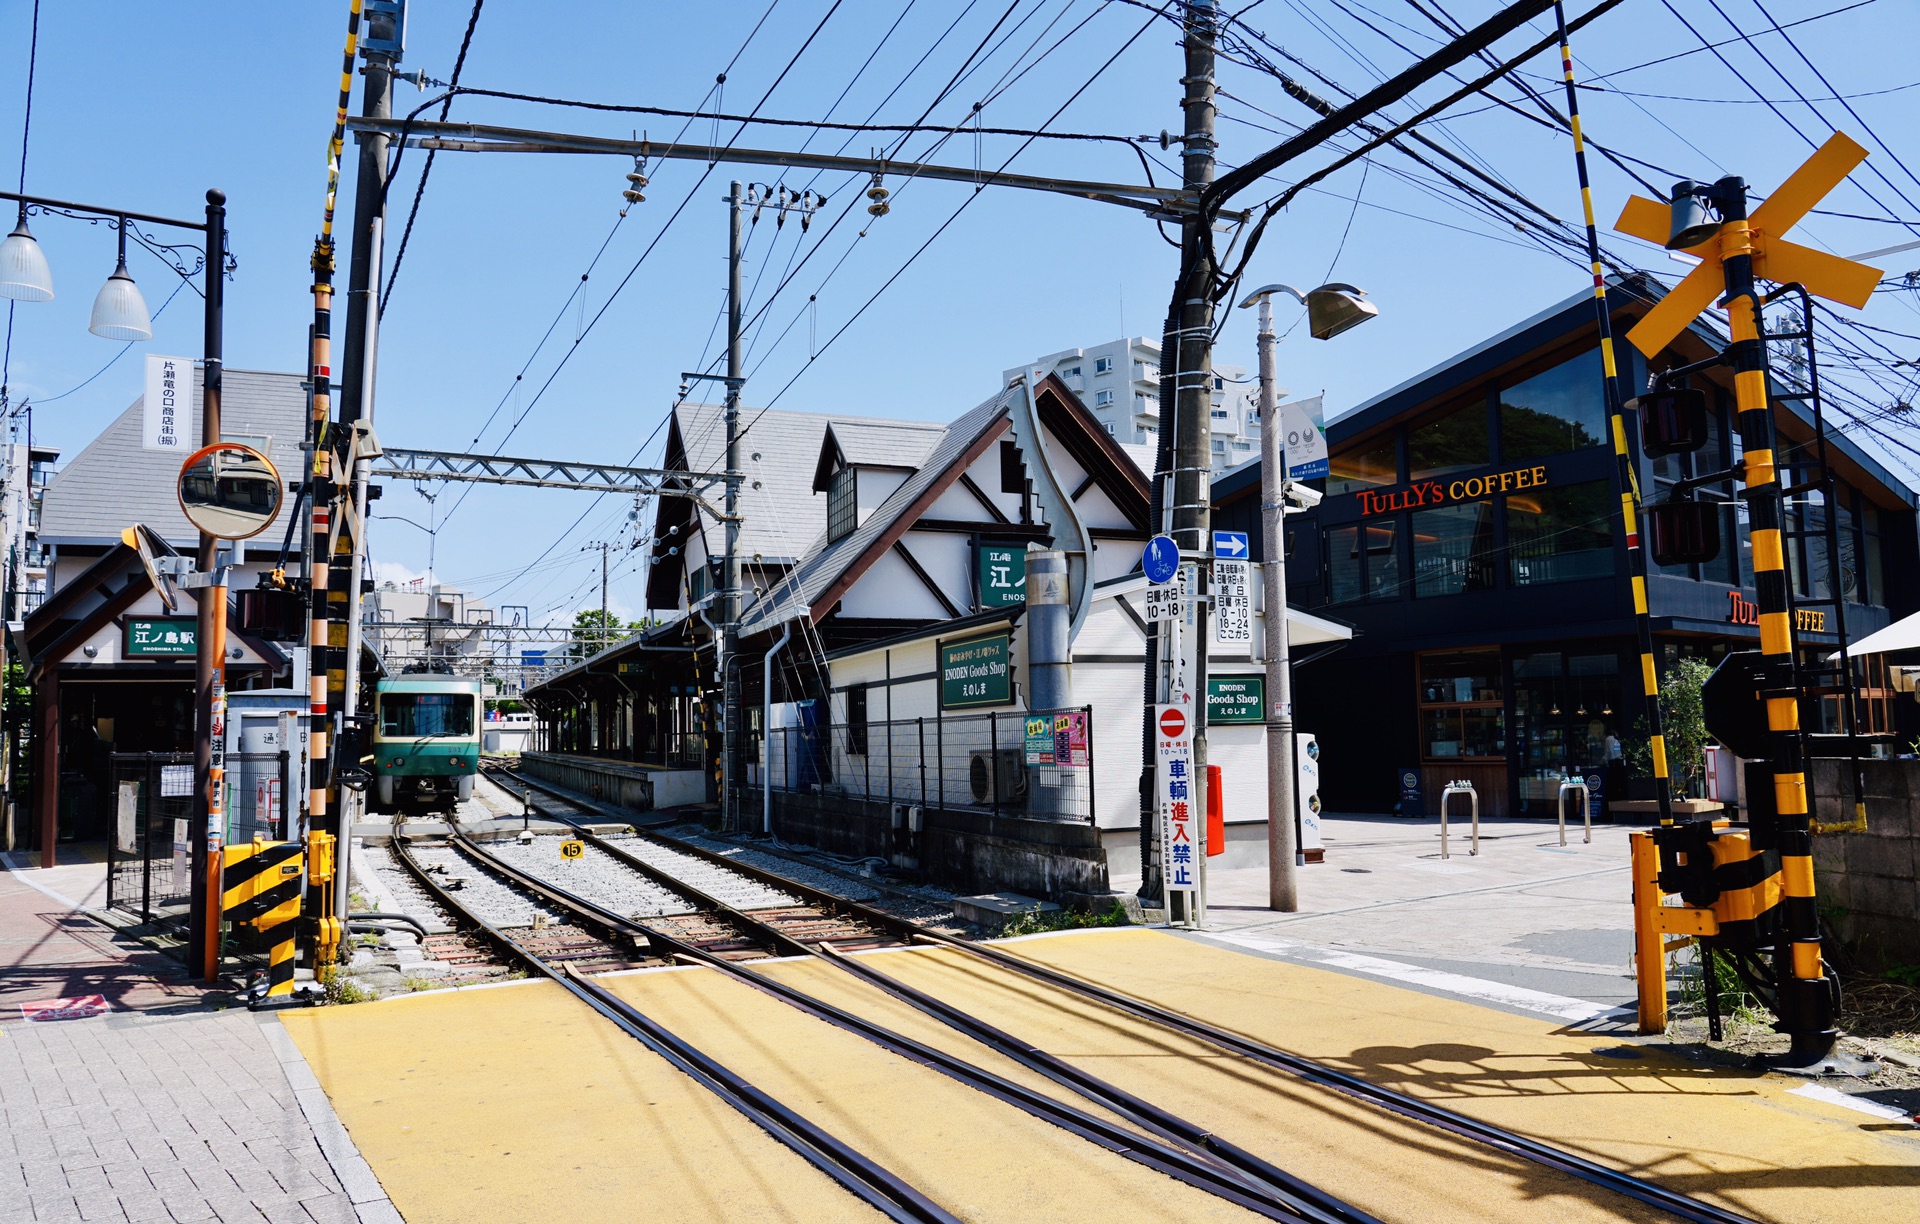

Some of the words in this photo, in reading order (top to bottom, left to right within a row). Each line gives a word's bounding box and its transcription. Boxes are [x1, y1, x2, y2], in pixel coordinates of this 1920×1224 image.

[1449, 465, 1547, 500] COFFEE
[1002, 593, 1026, 601] ENOS
[1795, 609, 1825, 632] FFEE
[135, 631, 194, 644] 江ノ島駅
[1220, 629, 1249, 639] ここから
[945, 666, 969, 681] ENODEN
[969, 663, 989, 678] Goods
[989, 661, 1006, 677] Shop
[962, 682, 986, 697] えのしま
[1219, 684, 1246, 692] ENODEN
[1208, 694, 1235, 704] Goods
[1236, 694, 1258, 705] Shop
[1220, 707, 1246, 715] えのしま
[211, 739, 223, 765] 注意
[566, 844, 578, 856] 15
